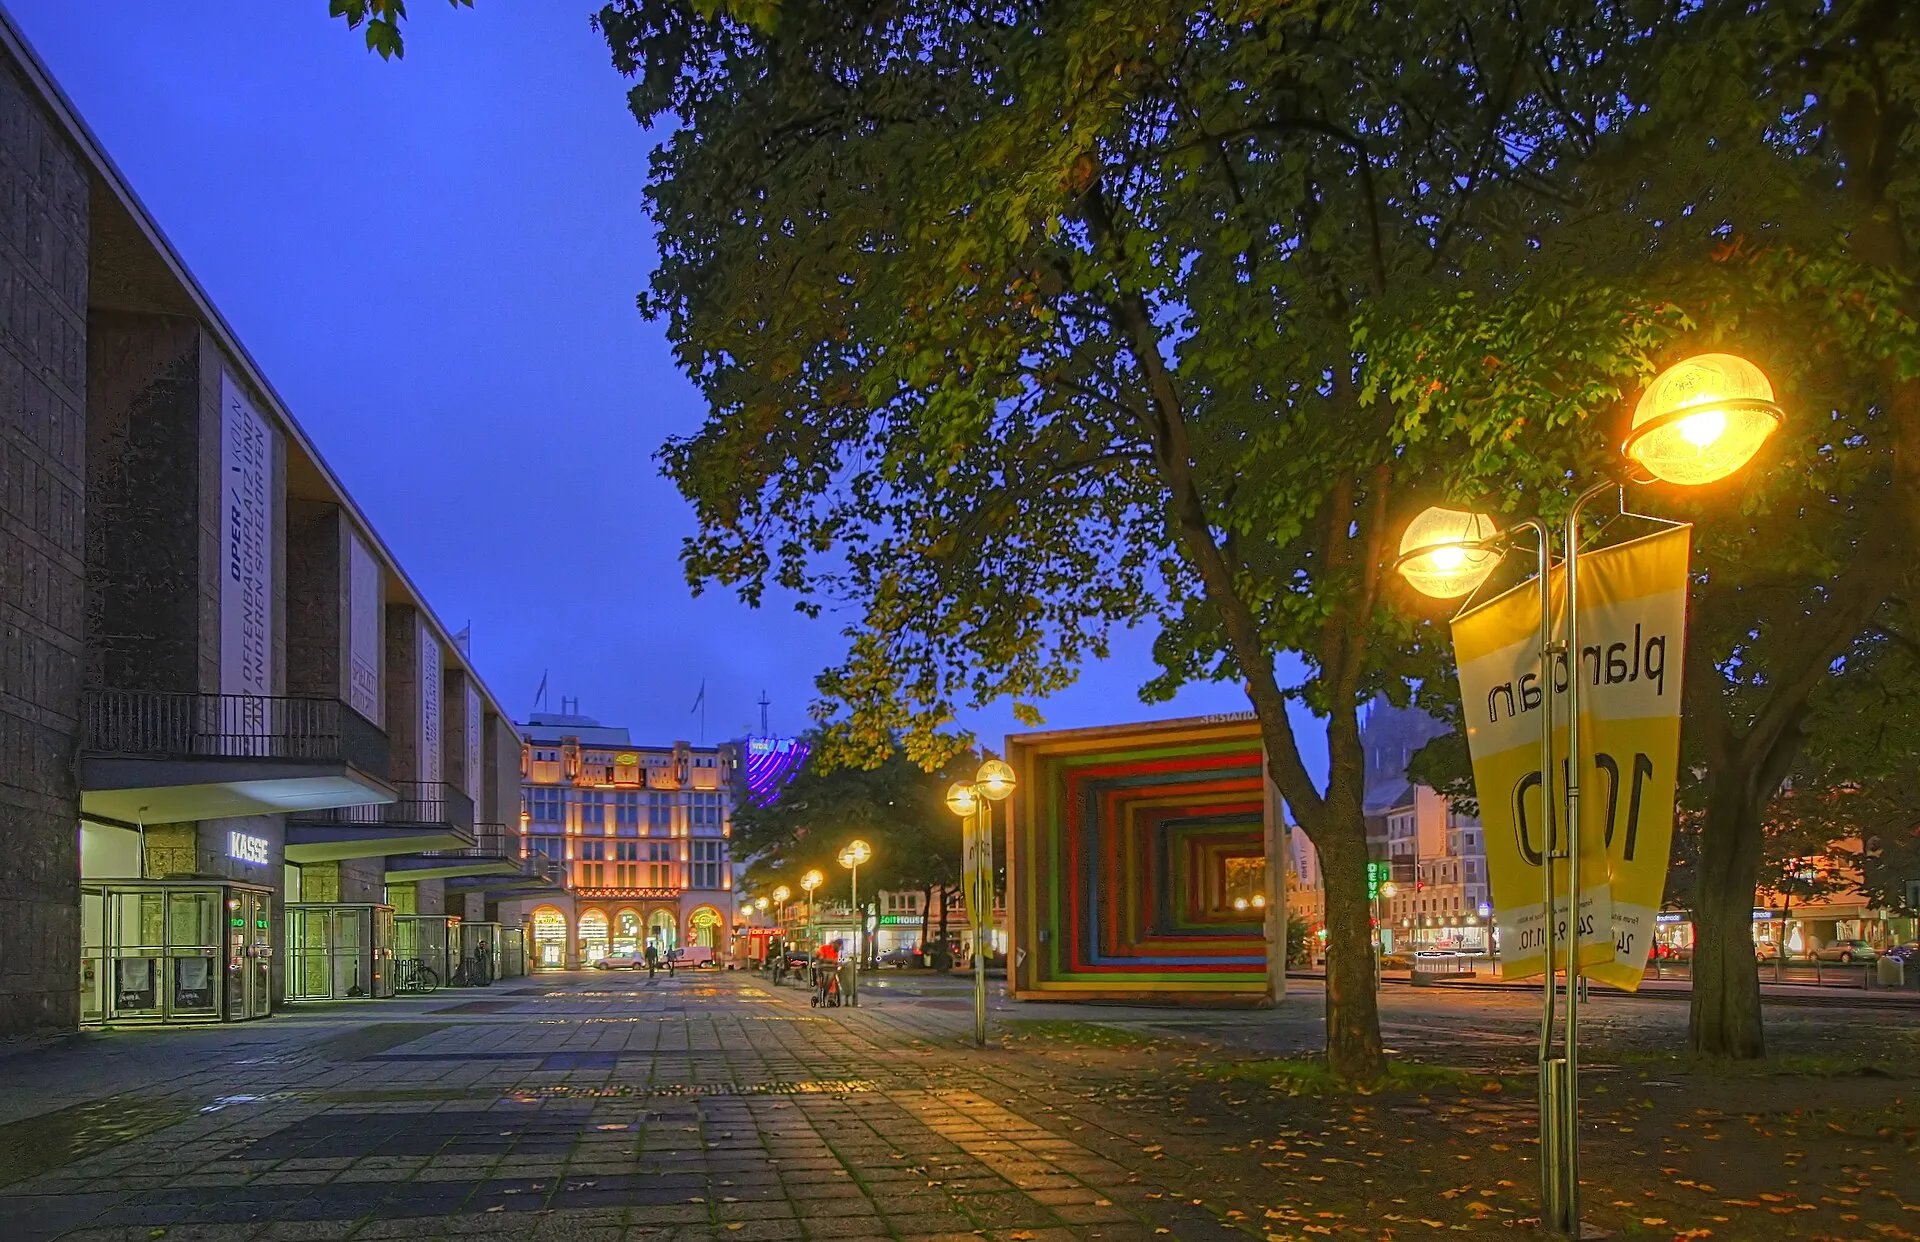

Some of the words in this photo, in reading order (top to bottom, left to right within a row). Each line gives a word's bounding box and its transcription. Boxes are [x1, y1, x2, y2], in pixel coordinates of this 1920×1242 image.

[243, 412, 253, 466] UND
[255, 426, 264, 574] SPIELORTEN
[243, 467, 253, 682] OFFENBACHPLATZ
[255, 579, 264, 690] ANDEREN
[229, 831, 269, 865] KASSE
